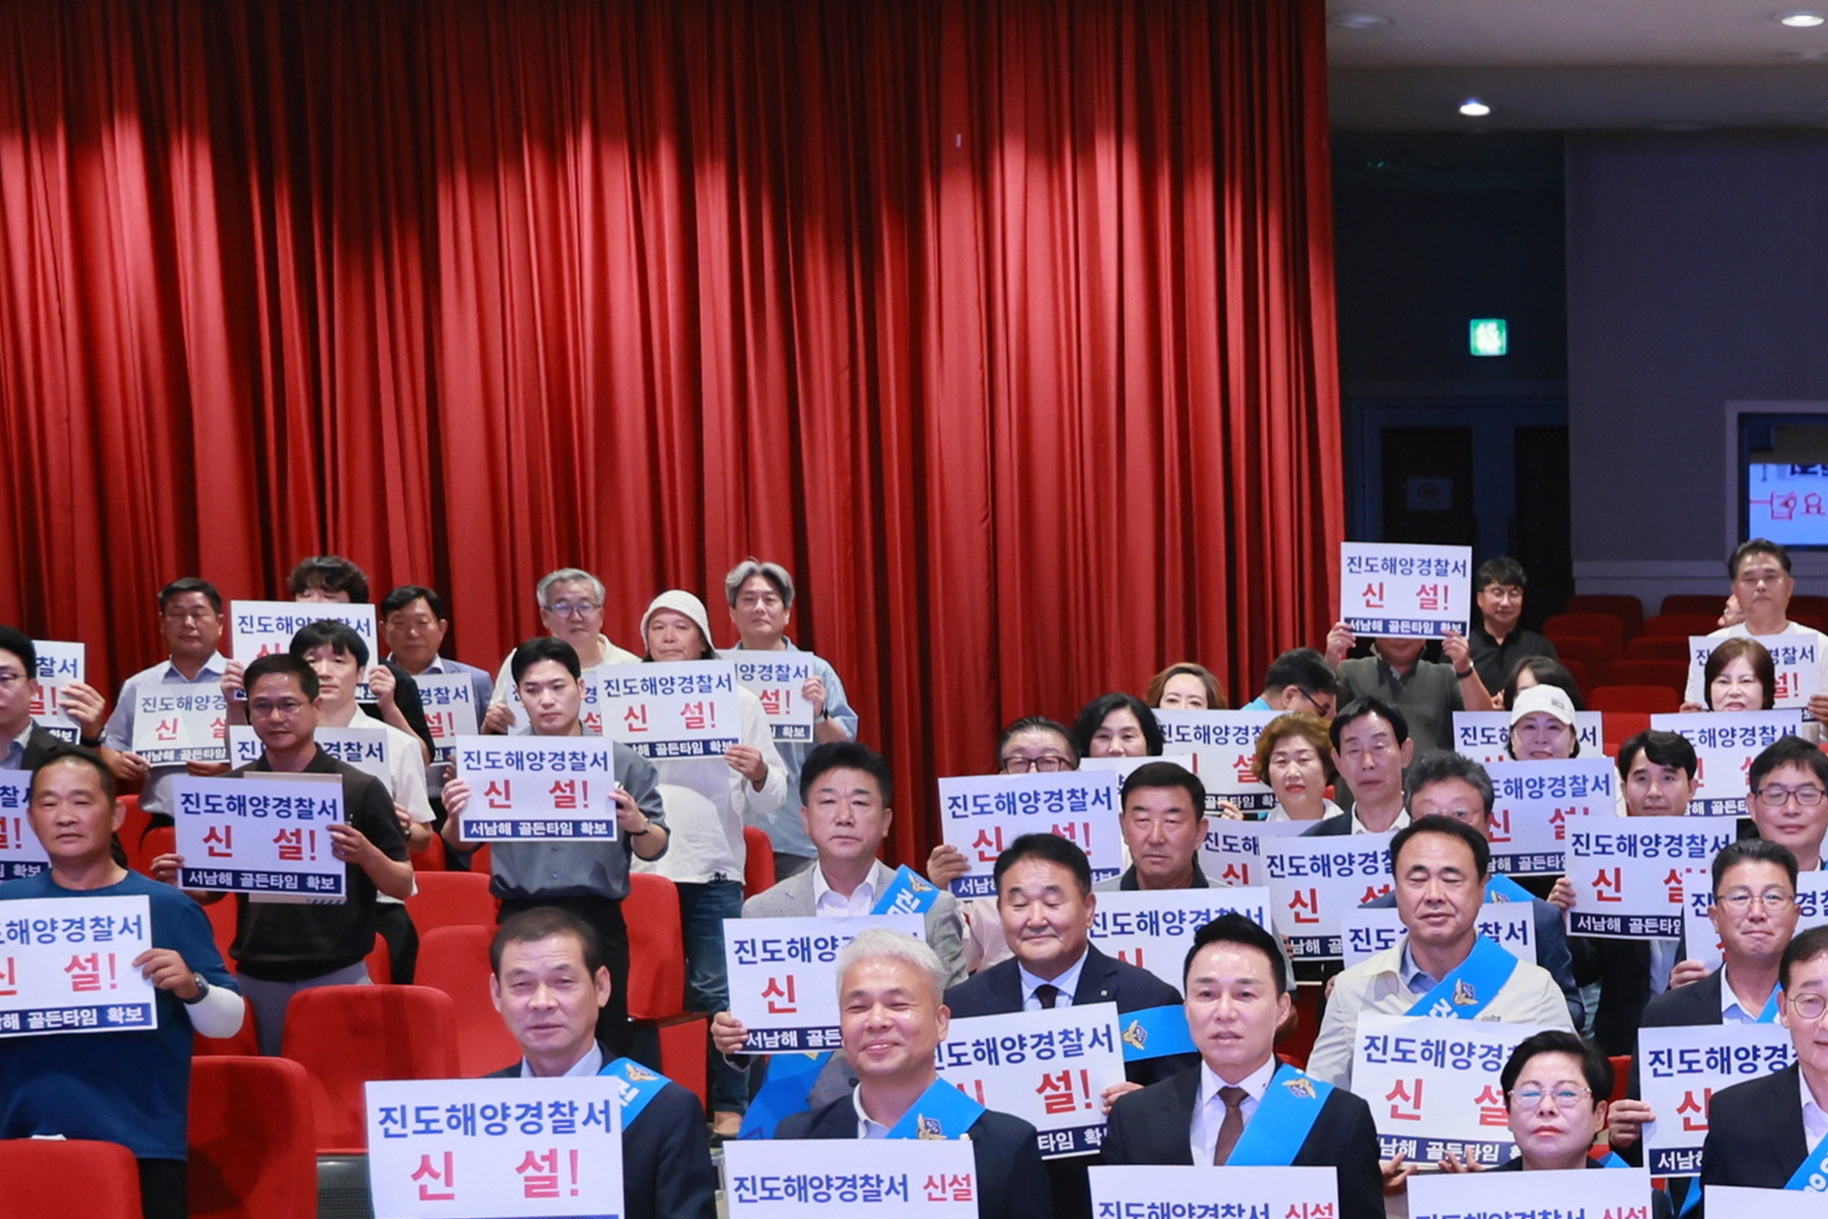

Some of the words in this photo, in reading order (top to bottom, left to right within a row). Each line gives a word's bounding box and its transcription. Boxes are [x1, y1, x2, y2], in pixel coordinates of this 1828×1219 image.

[1347, 556, 1467, 578] 진도해양경찰서
[1362, 582, 1384, 608] 신
[1416, 584, 1449, 610] 설!
[1389, 620, 1434, 634] 골든타임
[603, 674, 733, 696] 진도해양경찰서
[155, 718, 179, 740] 신
[624, 704, 648, 731] 신
[680, 701, 716, 728] 설!
[782, 725, 806, 738] 확보
[463, 750, 608, 772] 진도해양경찰서
[656, 742, 704, 755] 골든타임
[181, 791, 338, 820] 진도해양경찰서
[484, 780, 511, 808] 신
[549, 779, 589, 808] 설!
[948, 785, 1113, 820] 진도해양경찰서
[470, 823, 510, 837] 서남해
[519, 822, 573, 835] 골든타임
[580, 822, 608, 835] 확보
[1490, 810, 1511, 843] 신
[202, 825, 233, 858] 신
[273, 828, 317, 861] 설!
[972, 826, 1003, 862] 신
[189, 870, 233, 888] 서남해
[240, 872, 299, 890] 골든타임
[307, 875, 335, 892] 확보
[1592, 868, 1622, 902] 신
[1288, 888, 1319, 923] 신
[0, 914, 143, 944] 해양경찰서
[1578, 917, 1621, 933] 서남해
[733, 934, 852, 964] 진도해양
[1291, 938, 1321, 955] 남해
[64, 952, 117, 992] 설!
[761, 975, 797, 1014] 신
[27, 1008, 99, 1029] 골든타임
[107, 1005, 144, 1025] 확보
[747, 1029, 798, 1049] 서남해
[807, 1028, 841, 1047] 골든
[1648, 1044, 1798, 1077] 진도해양경
[1036, 1068, 1092, 1115] 설!
[1385, 1079, 1422, 1121] 신
[379, 1100, 611, 1139] 진도해양경찰서
[1676, 1089, 1710, 1131] 신
[1038, 1126, 1074, 1153] 타임
[1379, 1138, 1416, 1157] 남해
[411, 1151, 455, 1201] 신
[515, 1149, 578, 1198] 설!
[733, 1173, 908, 1204] 진도해양경찰서
[923, 1173, 972, 1202] 신설
